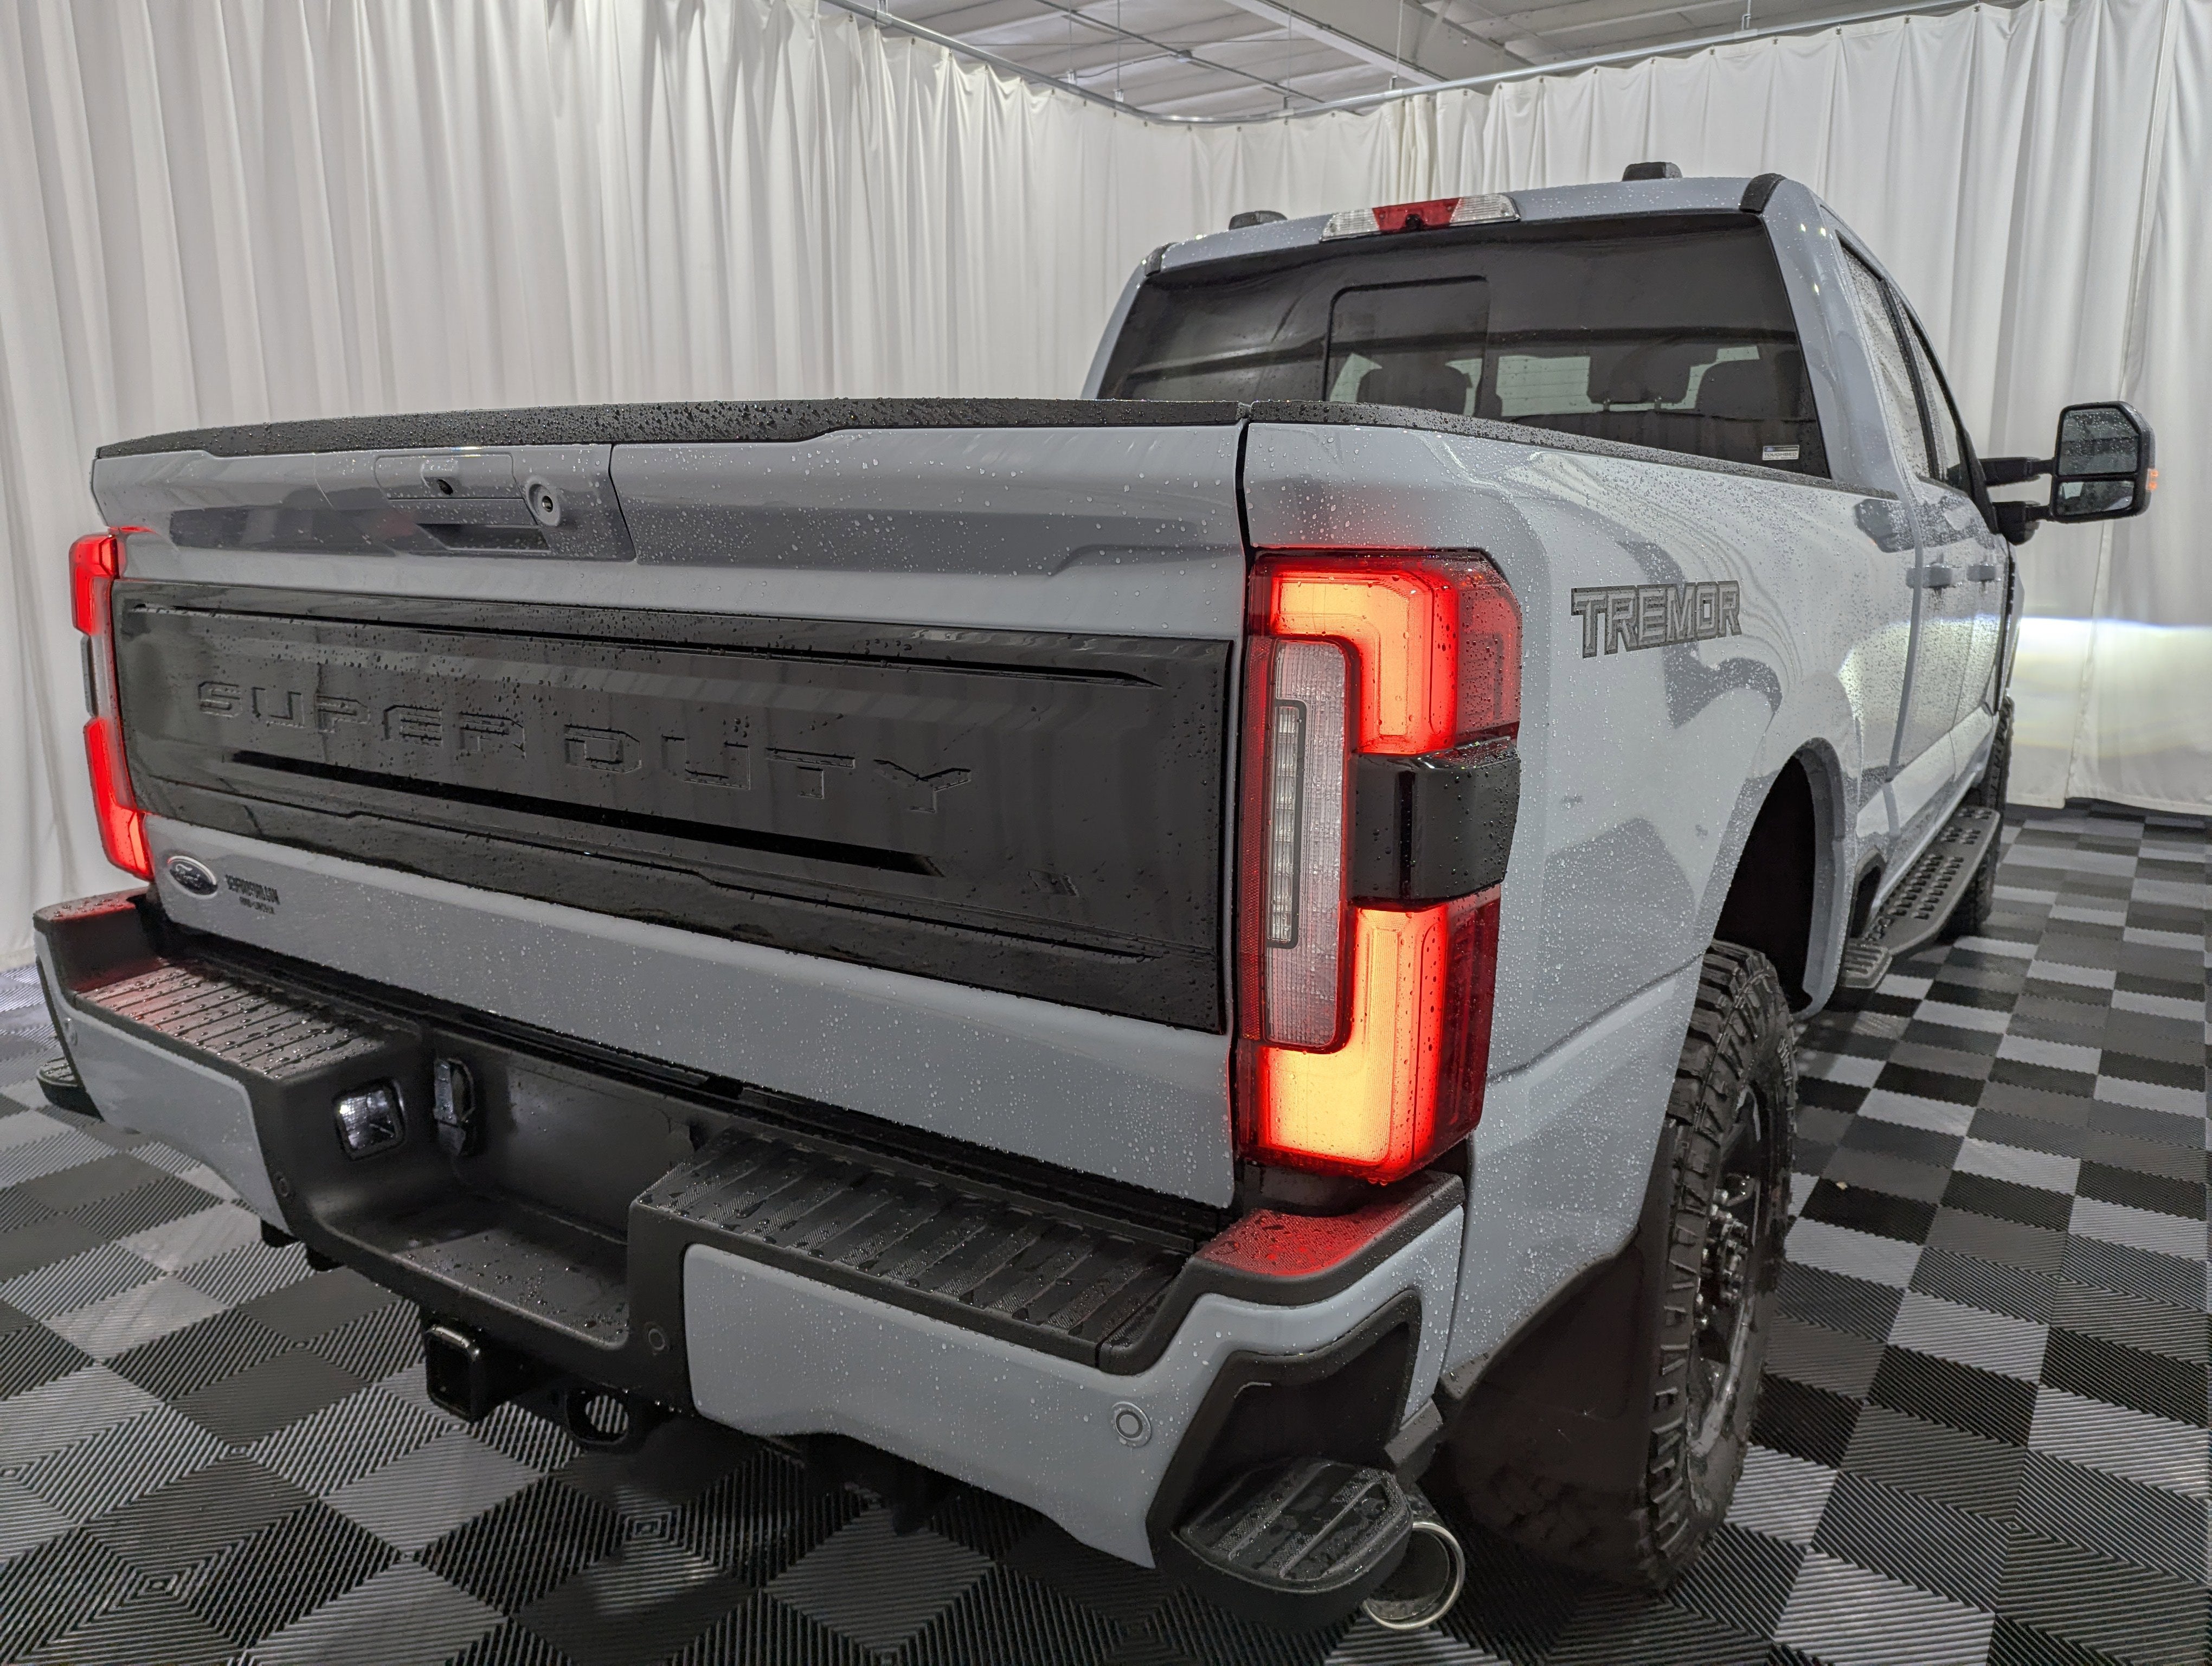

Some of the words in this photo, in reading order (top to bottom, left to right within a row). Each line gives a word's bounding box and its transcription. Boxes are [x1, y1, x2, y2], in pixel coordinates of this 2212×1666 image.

[1571, 580, 1742, 658] TREMOR
[197, 681, 527, 760] SUPER
[564, 723, 972, 813] DUTY
[175, 863, 203, 890] Ford
